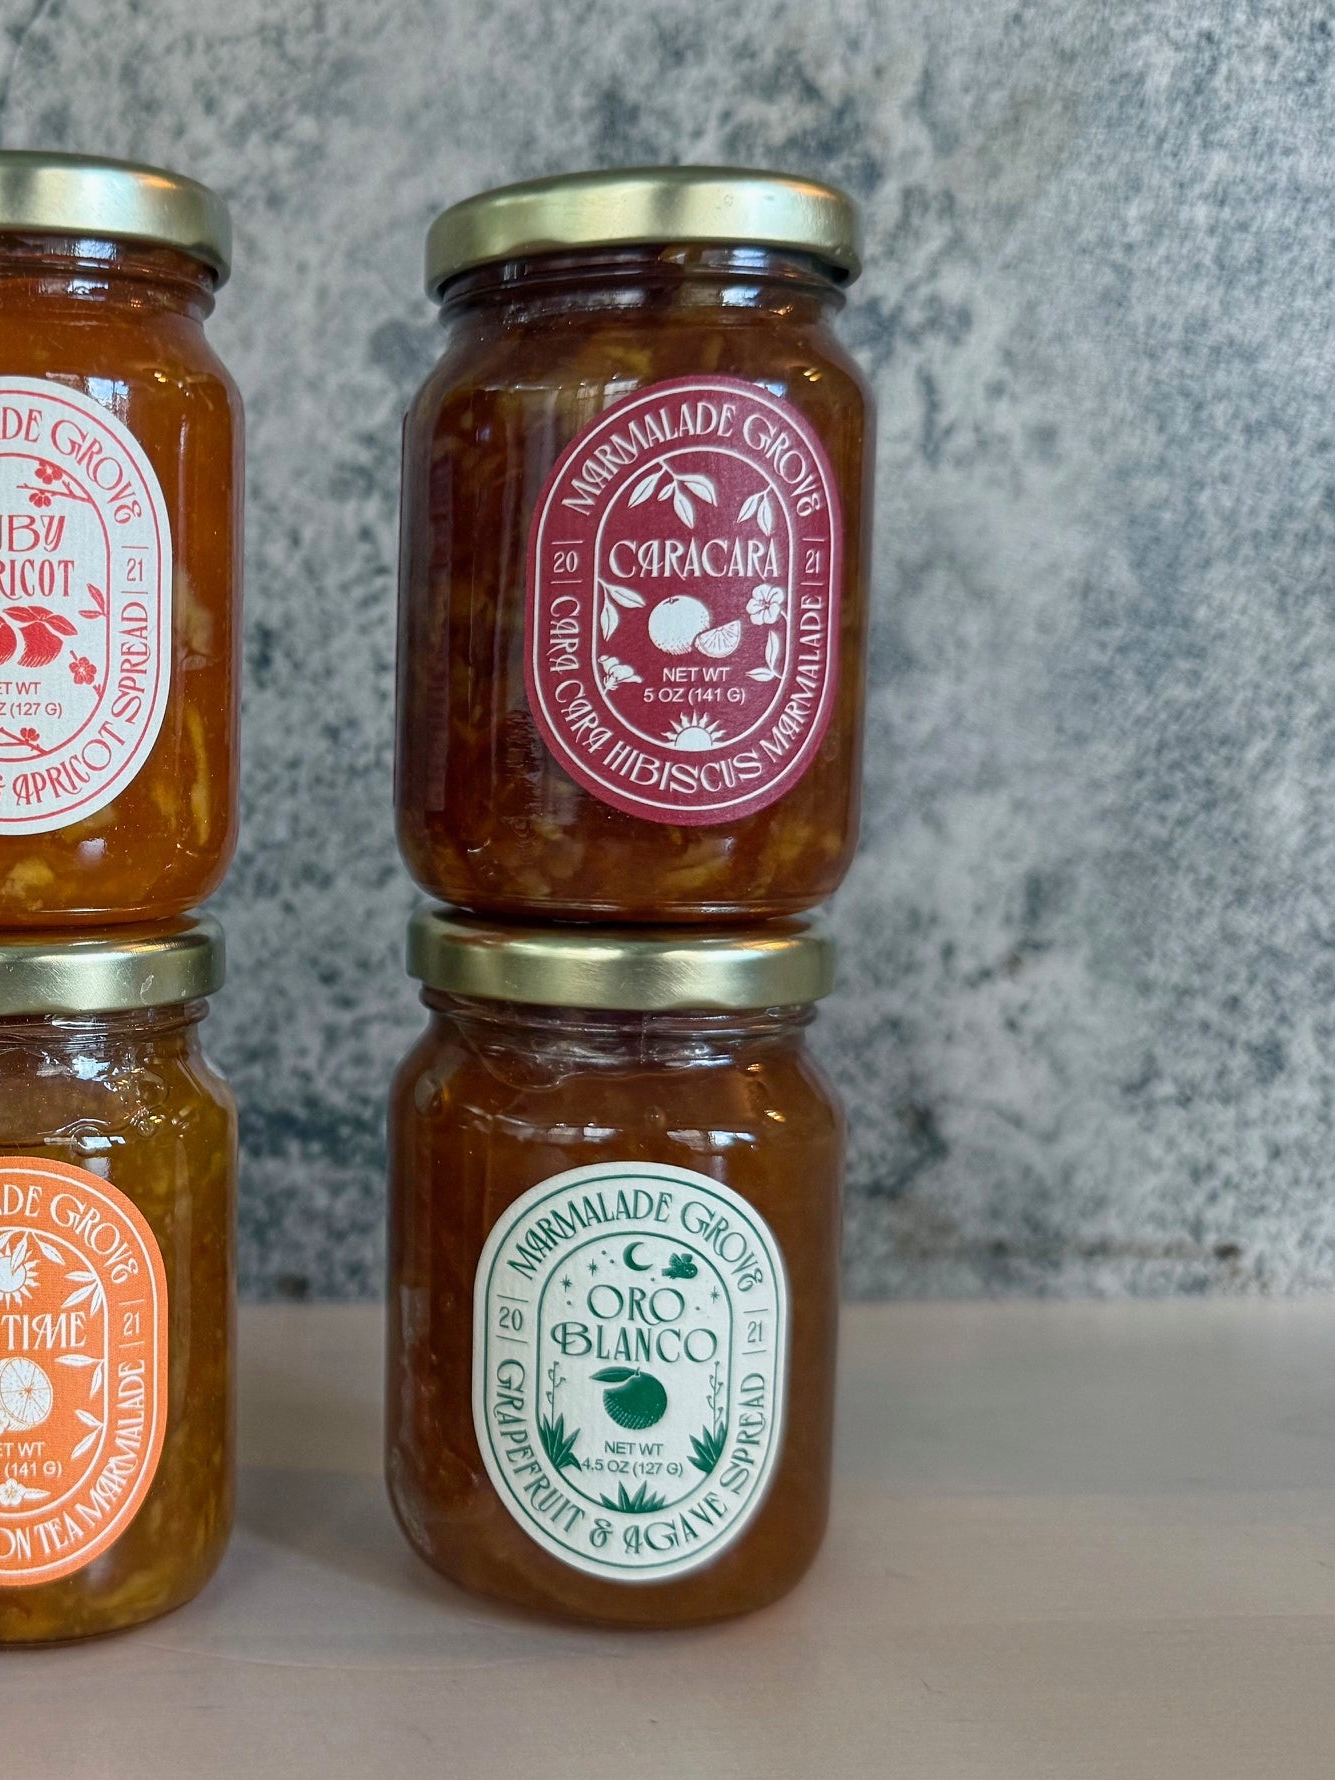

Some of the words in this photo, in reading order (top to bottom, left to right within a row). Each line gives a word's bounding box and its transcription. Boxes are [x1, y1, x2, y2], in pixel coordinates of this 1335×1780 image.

[50, 419, 143, 525] GROVE
[562, 402, 735, 516] MARMALADE
[743, 415, 824, 517] GROVE
[127, 558, 143, 581] 21
[554, 551, 577, 573] 20
[609, 537, 779, 580] CARACARA
[806, 551, 819, 572] 21
[550, 596, 580, 673] CARA
[16, 682, 40, 695] WT
[663, 668, 698, 682] NET
[703, 668, 730, 682] WT
[760, 597, 824, 763] MARMALADE
[10, 702, 41, 718] (127
[45, 702, 63, 718] G)
[13, 721, 127, 806] APRICOT
[112, 601, 149, 724] SPREAD
[643, 689, 652, 701] 5
[658, 689, 684, 702] OZ
[689, 688, 723, 704] (141
[728, 688, 745, 704] G)
[555, 680, 612, 754] CARA
[603, 740, 762, 794] HIBISCUS
[50, 1194, 139, 1285] GROVE
[507, 1189, 672, 1281] MARMALADE
[680, 1201, 764, 1292] GROVE
[124, 1313, 140, 1335] 21
[499, 1307, 523, 1331] 20
[587, 1285, 684, 1325] ORO
[1, 1312, 87, 1351] TIME
[551, 1322, 718, 1362] BLANCO
[748, 1322, 763, 1343] 21
[17, 1442, 45, 1456] WT
[35, 1517, 84, 1556] TEA
[75, 1359, 145, 1525] MARMALADE
[494, 1359, 585, 1533] GRAPEFRUIT
[589, 1519, 613, 1547] &
[624, 1491, 728, 1554] AGAVE
[720, 1372, 765, 1494] SPREAD
[581, 1458, 603, 1472] 4.5
[608, 1460, 629, 1473] OZ
[633, 1460, 662, 1476] (127
[666, 1461, 683, 1477] G)
[604, 1441, 638, 1455] NET
[640, 1443, 663, 1456] WT
[4, 1462, 38, 1477] (141
[44, 1462, 62, 1477] G)
